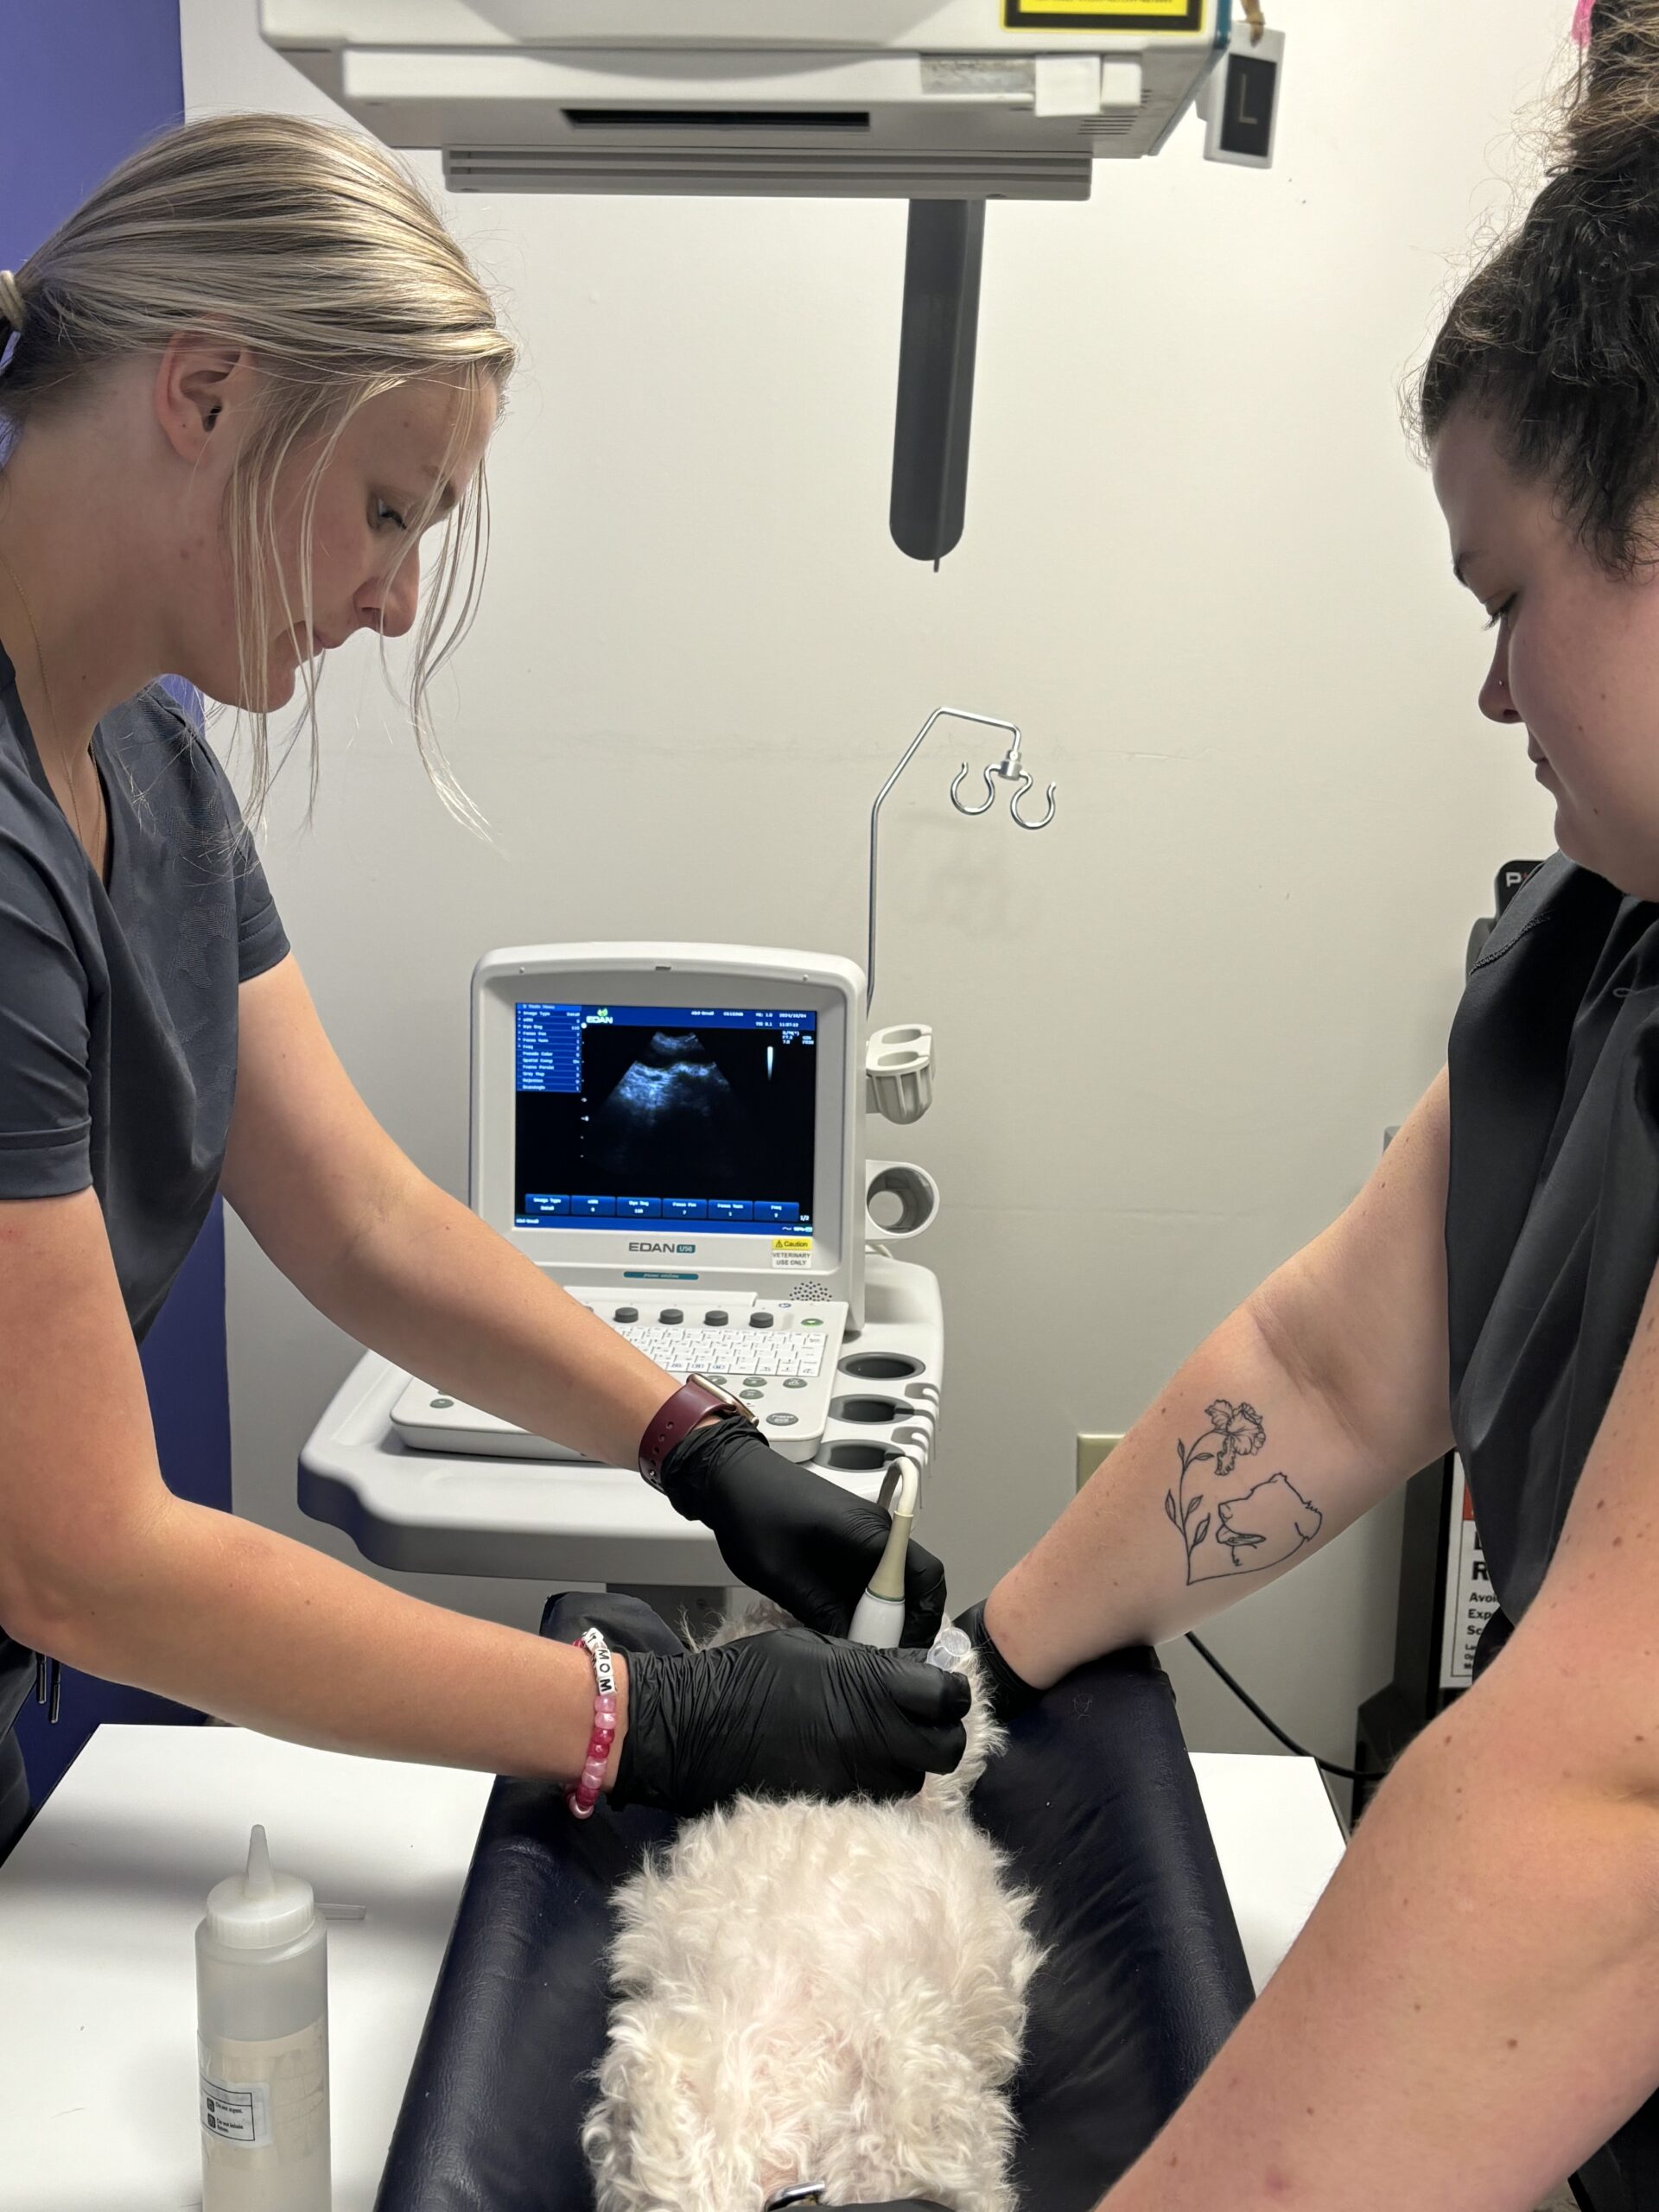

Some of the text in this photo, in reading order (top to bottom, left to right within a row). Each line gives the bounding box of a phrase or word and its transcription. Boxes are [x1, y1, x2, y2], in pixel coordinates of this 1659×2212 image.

[1239, 74, 1258, 124] L
[586, 1015, 613, 1024] EDAN
[628, 1243, 675, 1253] EDAN
[1471, 1560, 1489, 1581] R
[1469, 1592, 1498, 1603] Avoi
[1467, 1609, 1492, 1620] Exp
[1466, 1625, 1483, 1636] Sc
[597, 1649, 613, 1693] MOM
